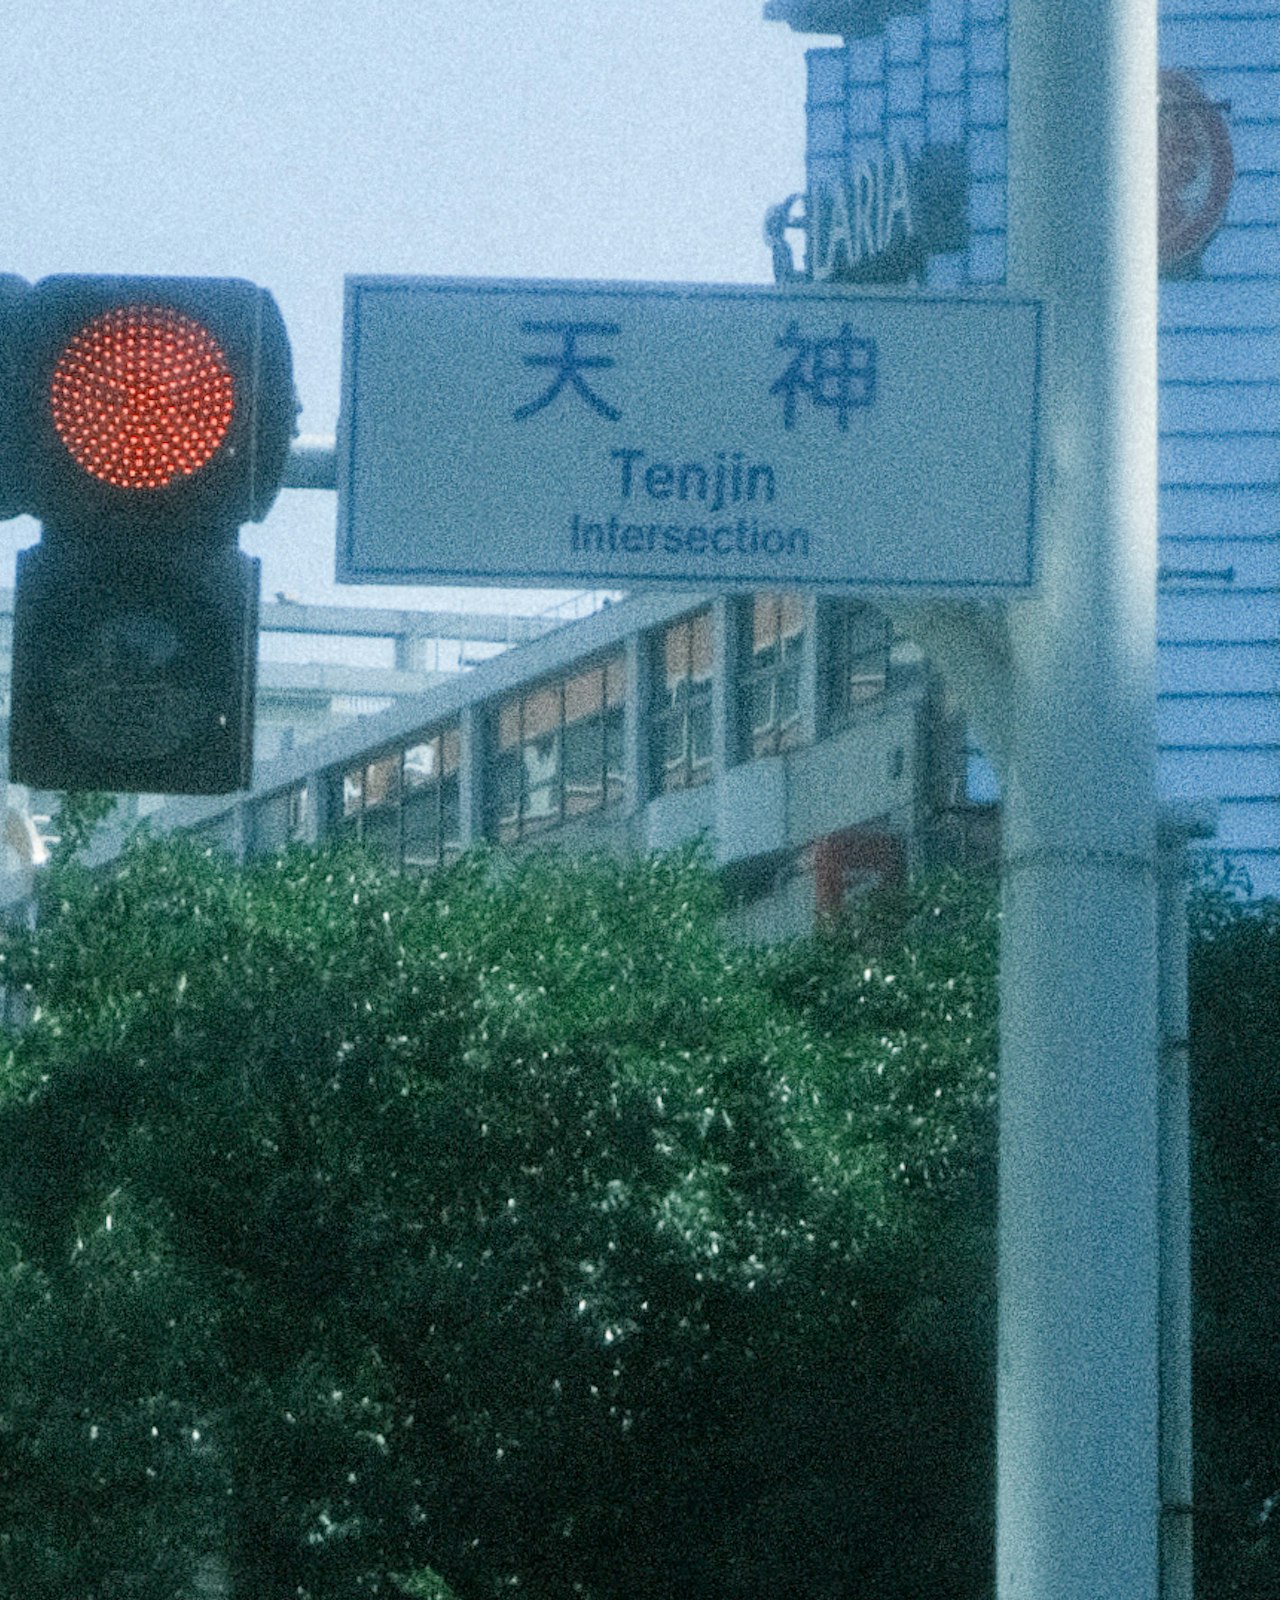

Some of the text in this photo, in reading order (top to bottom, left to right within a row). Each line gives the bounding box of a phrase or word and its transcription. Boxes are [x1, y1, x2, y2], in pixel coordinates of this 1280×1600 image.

[512, 320, 880, 431] 天神
[610, 449, 777, 512] Tenjin
[570, 514, 811, 558] Intersection
